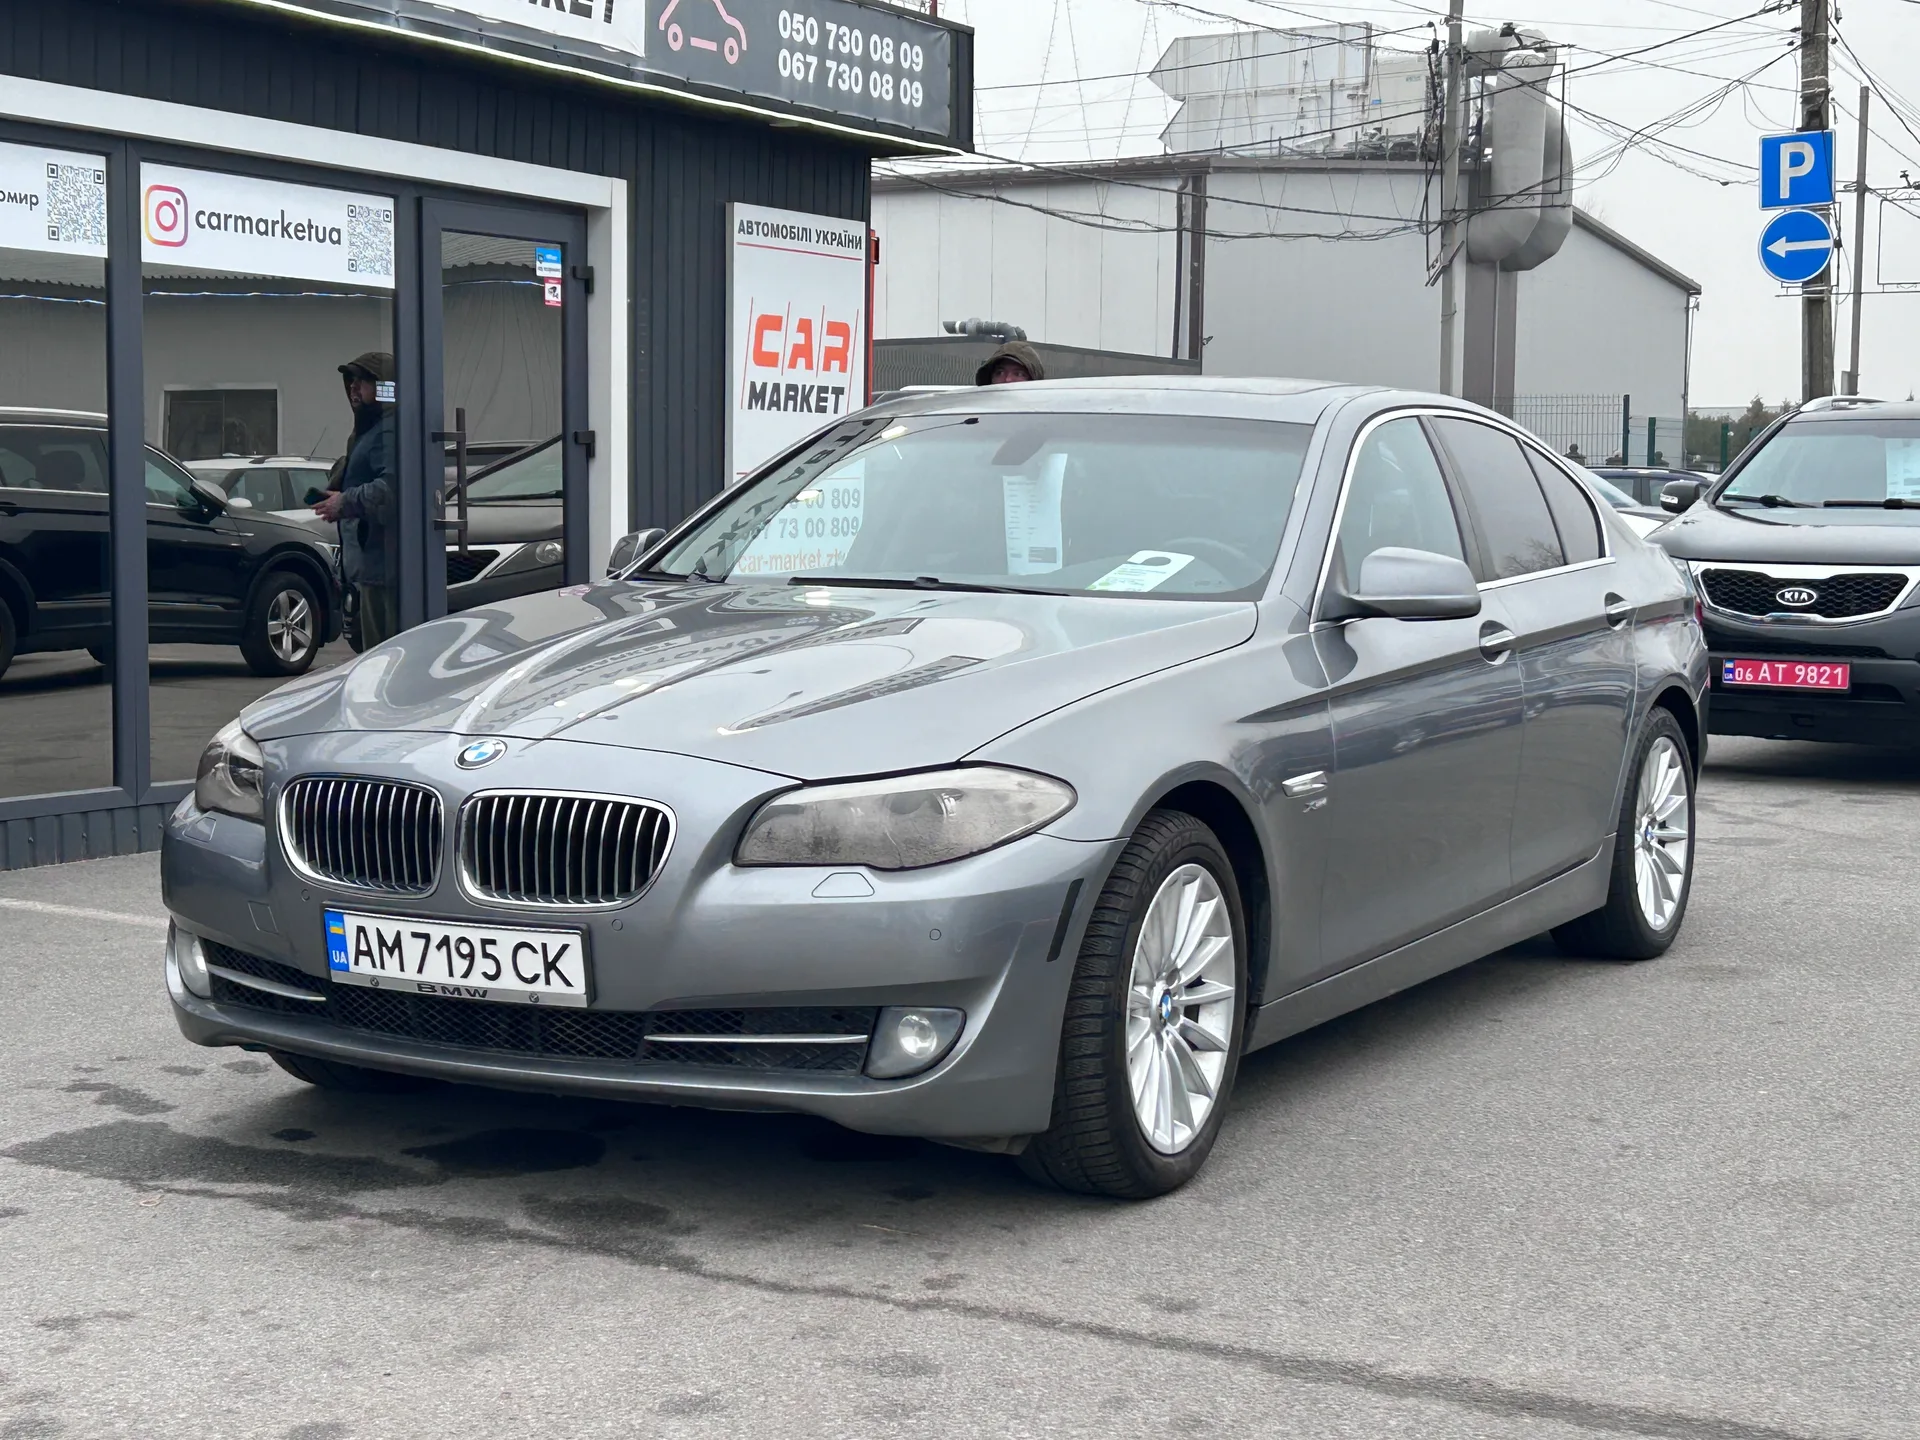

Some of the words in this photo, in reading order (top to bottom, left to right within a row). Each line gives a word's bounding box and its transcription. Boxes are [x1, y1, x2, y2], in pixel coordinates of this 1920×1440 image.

[778, 9, 819, 46] 050
[825, 21, 863, 57] 730
[869, 33, 894, 65] 08
[900, 41, 923, 72] 09
[778, 48, 818, 83] 067
[825, 59, 863, 94] 730
[869, 70, 894, 101] 08
[900, 77, 923, 108] 09
[1780, 141, 1815, 199] P
[194, 209, 342, 246] carmarketua
[737, 218, 813, 244] АВТОМОБІЛІ
[815, 229, 863, 251] УКРАЇНИ
[752, 313, 851, 374] CAR
[747, 380, 845, 415] MARKET
[831, 488, 861, 509] 809
[778, 517, 799, 539] 73
[805, 517, 825, 538] 00
[831, 516, 860, 538] 809
[1784, 591, 1809, 602] KIA
[1735, 667, 1754, 681] 06
[1757, 662, 1788, 682] AT
[1794, 664, 1843, 686] 9821
[332, 952, 348, 965] UA
[353, 925, 405, 973] AM
[410, 931, 502, 982] 7195
[511, 941, 575, 988] CK
[417, 982, 488, 999] BMW
